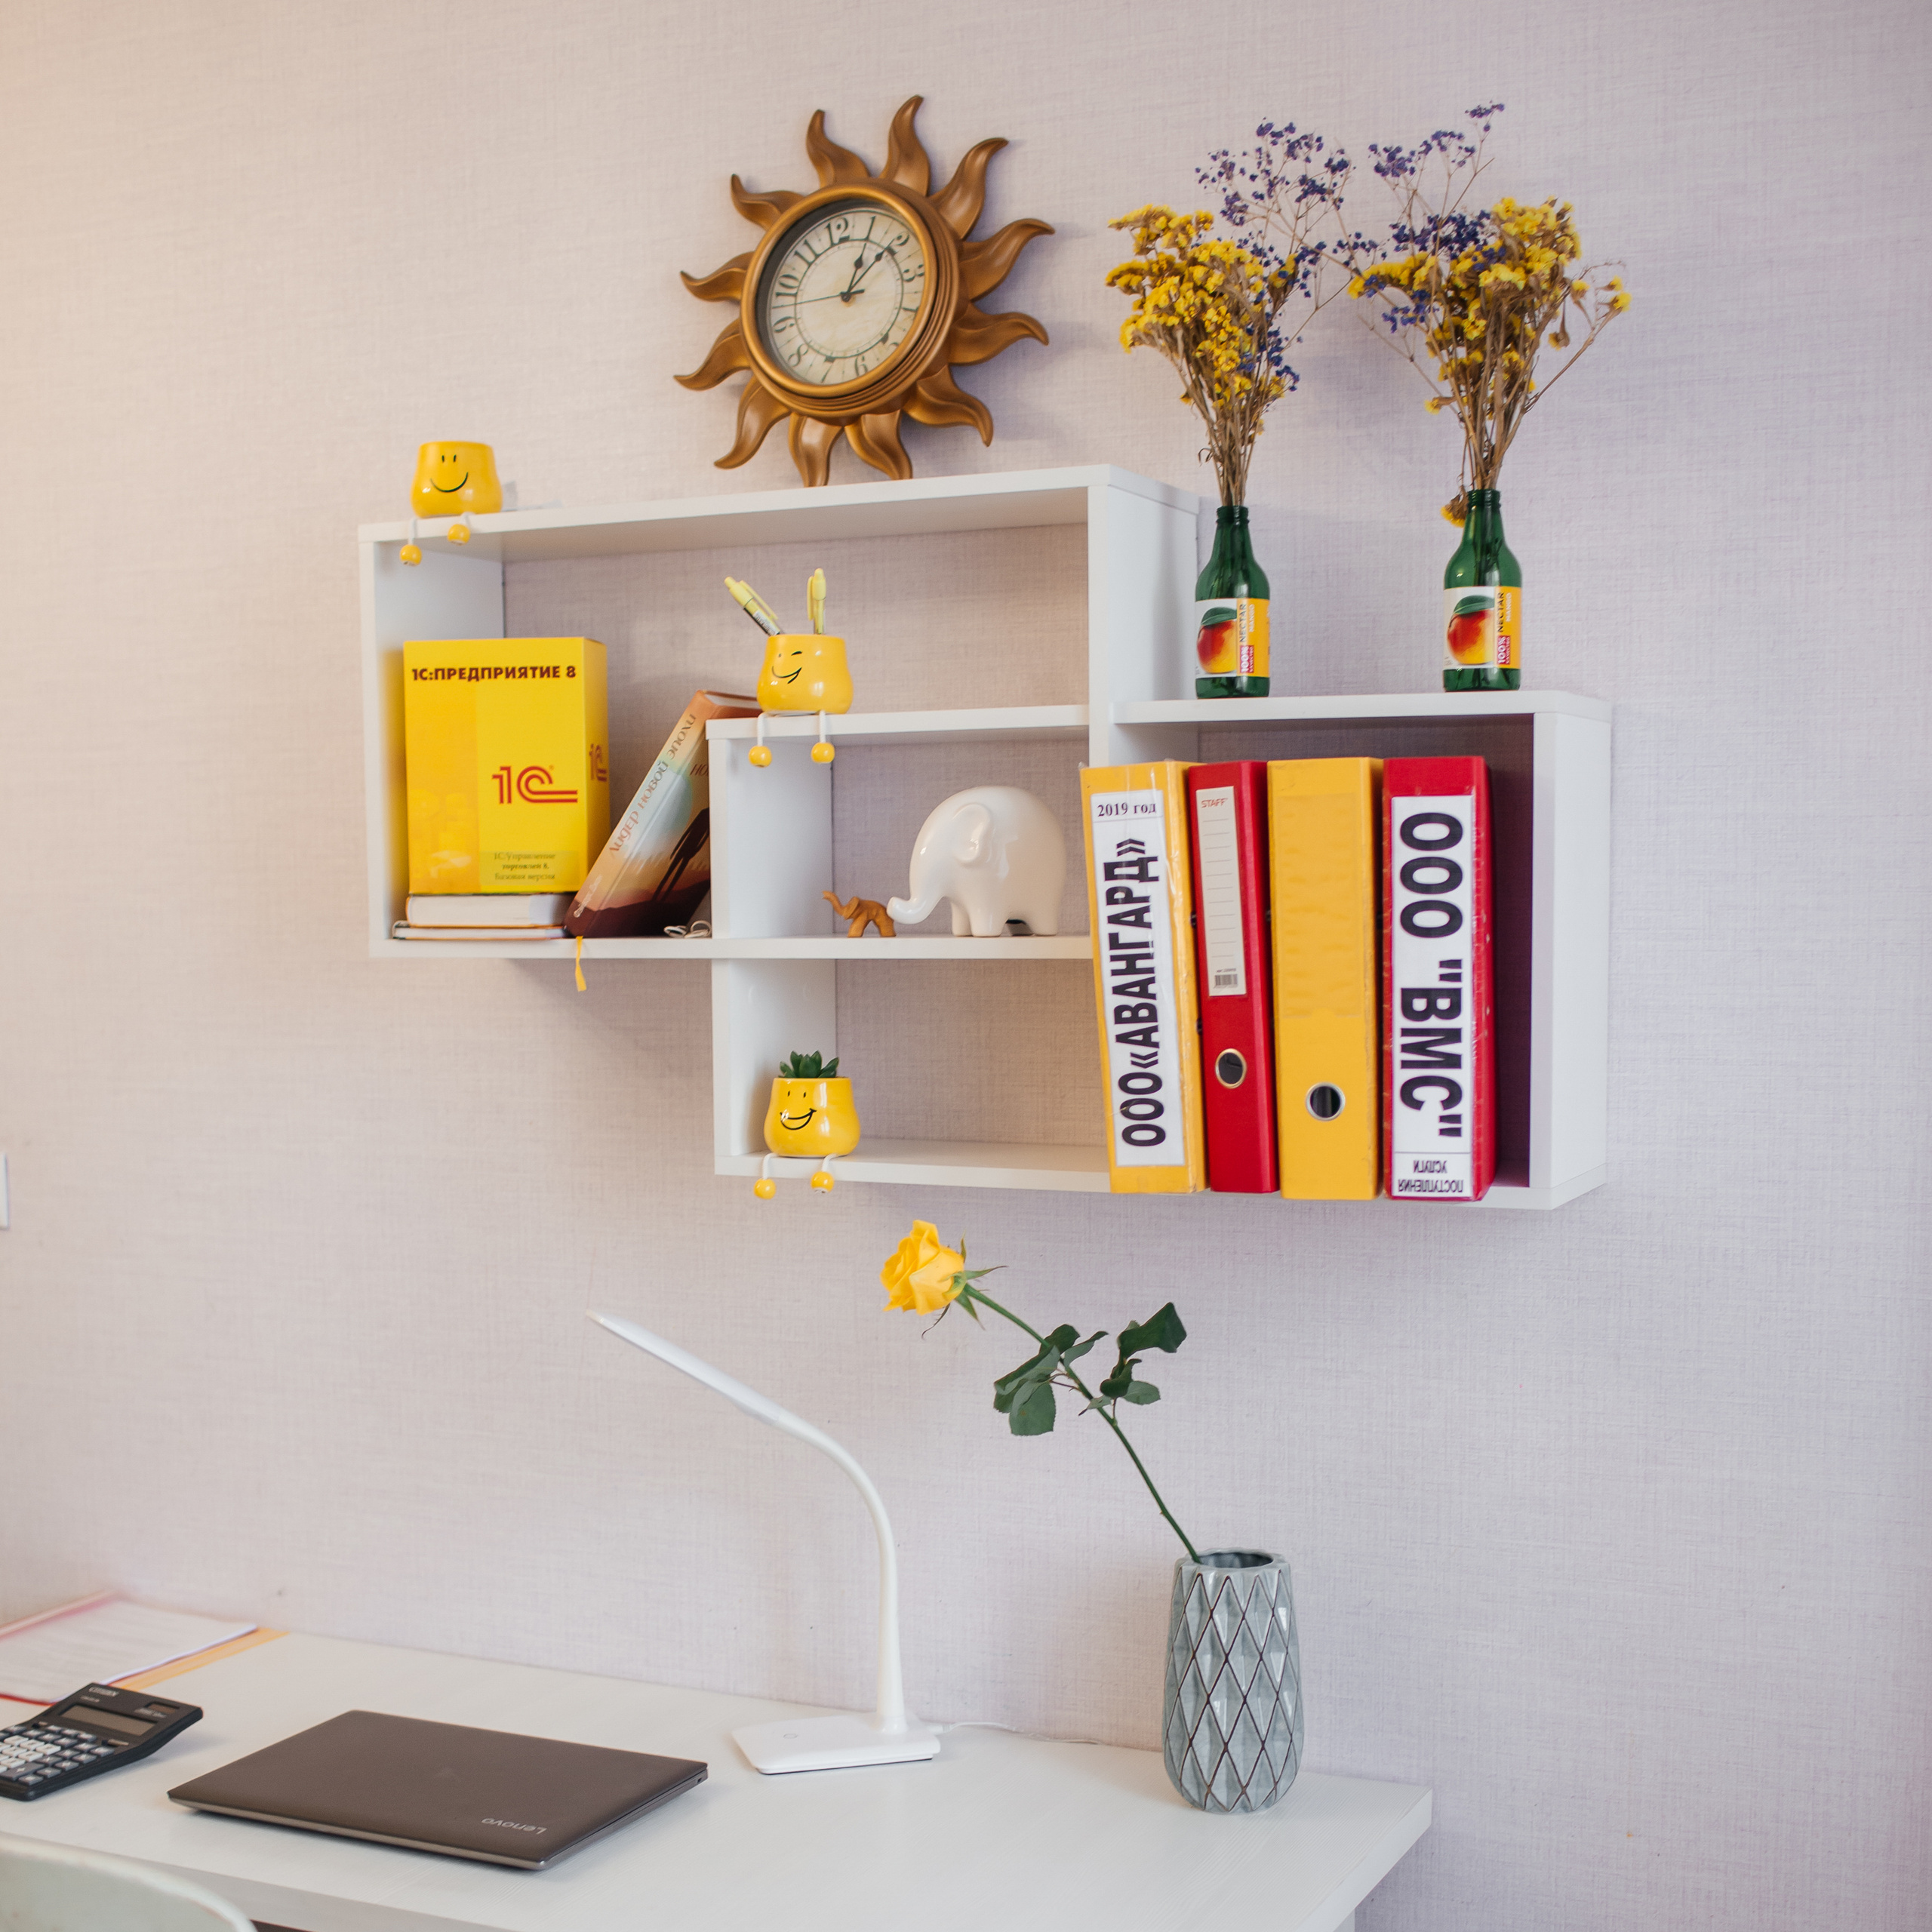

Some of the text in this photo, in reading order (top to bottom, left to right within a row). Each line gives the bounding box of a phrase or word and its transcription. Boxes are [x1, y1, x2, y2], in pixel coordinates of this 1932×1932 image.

[825, 217, 850, 247] 12
[864, 216, 876, 241] 1
[794, 239, 821, 266] 11
[884, 232, 910, 257] 2
[776, 274, 800, 298] 10
[773, 316, 795, 333] 9
[787, 343, 808, 368] 8
[412, 666, 577, 682] 1С:ПРЕДПРИЯТИЕ 8
[492, 766, 578, 804] 1С
[1097, 802, 1157, 818] 2019 год
[1201, 798, 1228, 808] STAFF
[1399, 813, 1463, 1137] ООО "ВМС"
[1414, 1161, 1447, 1173] УСЛУГИ
[1398, 1180, 1463, 1192] ПОСТУПЛЕНИЯ
[481, 1818, 547, 1835] Lenovo
